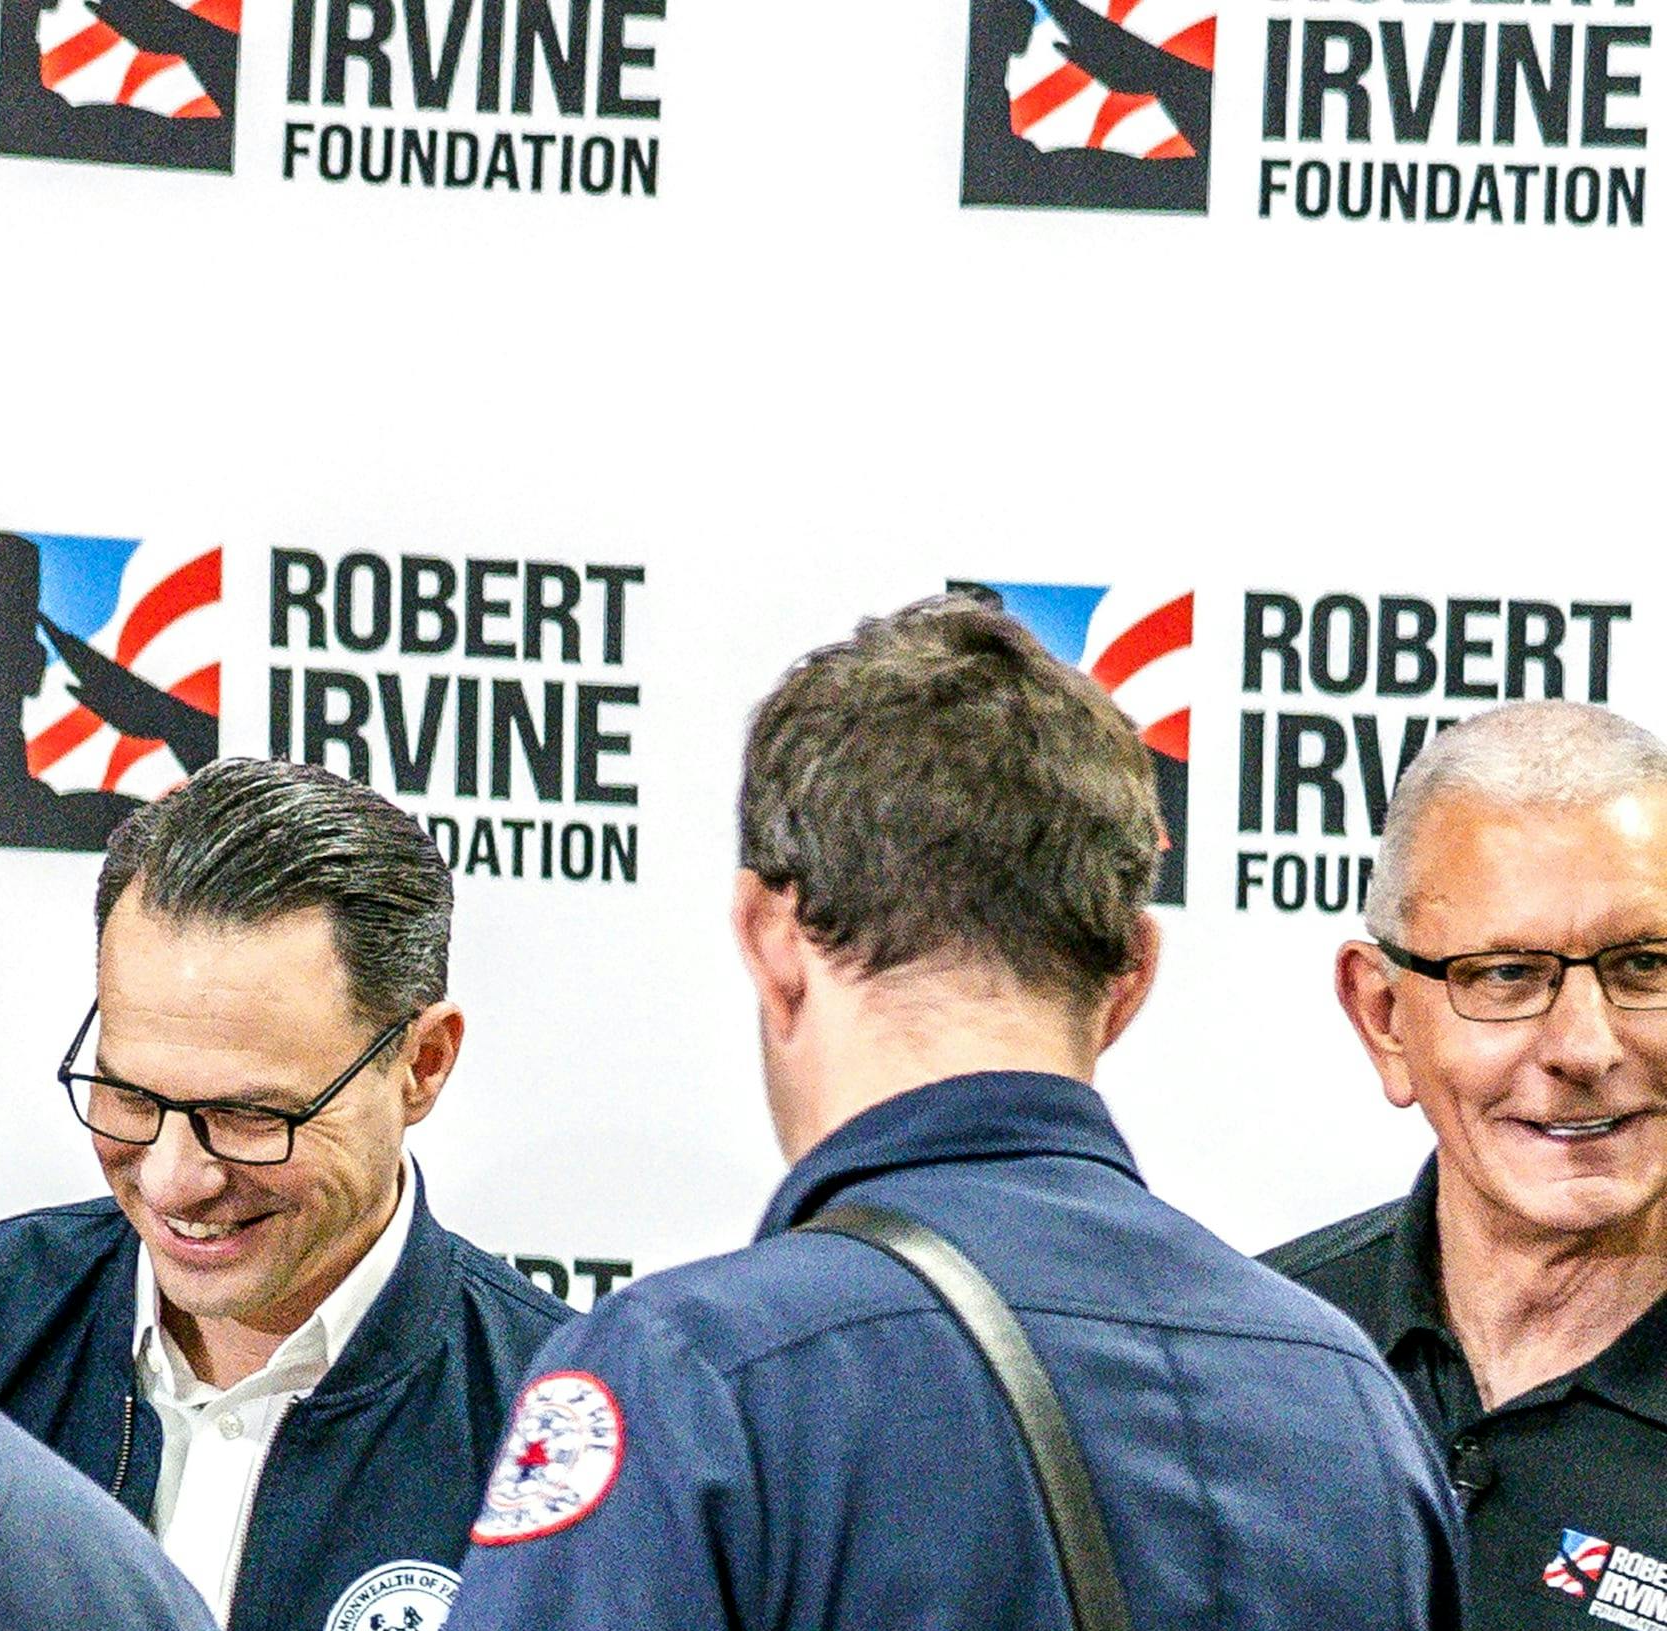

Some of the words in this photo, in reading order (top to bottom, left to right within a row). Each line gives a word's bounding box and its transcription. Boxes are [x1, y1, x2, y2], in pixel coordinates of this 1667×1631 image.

[285, 0, 666, 119] IRVINE
[1261, 18, 1652, 148] IRVINE
[282, 121, 659, 197] FOUNDATION
[1258, 157, 1647, 228] FOUNDATION
[269, 546, 646, 665] ROBERT
[1241, 590, 1633, 704] ROBERT
[269, 666, 641, 806] IRVINE
[418, 1574, 439, 1590] OF
